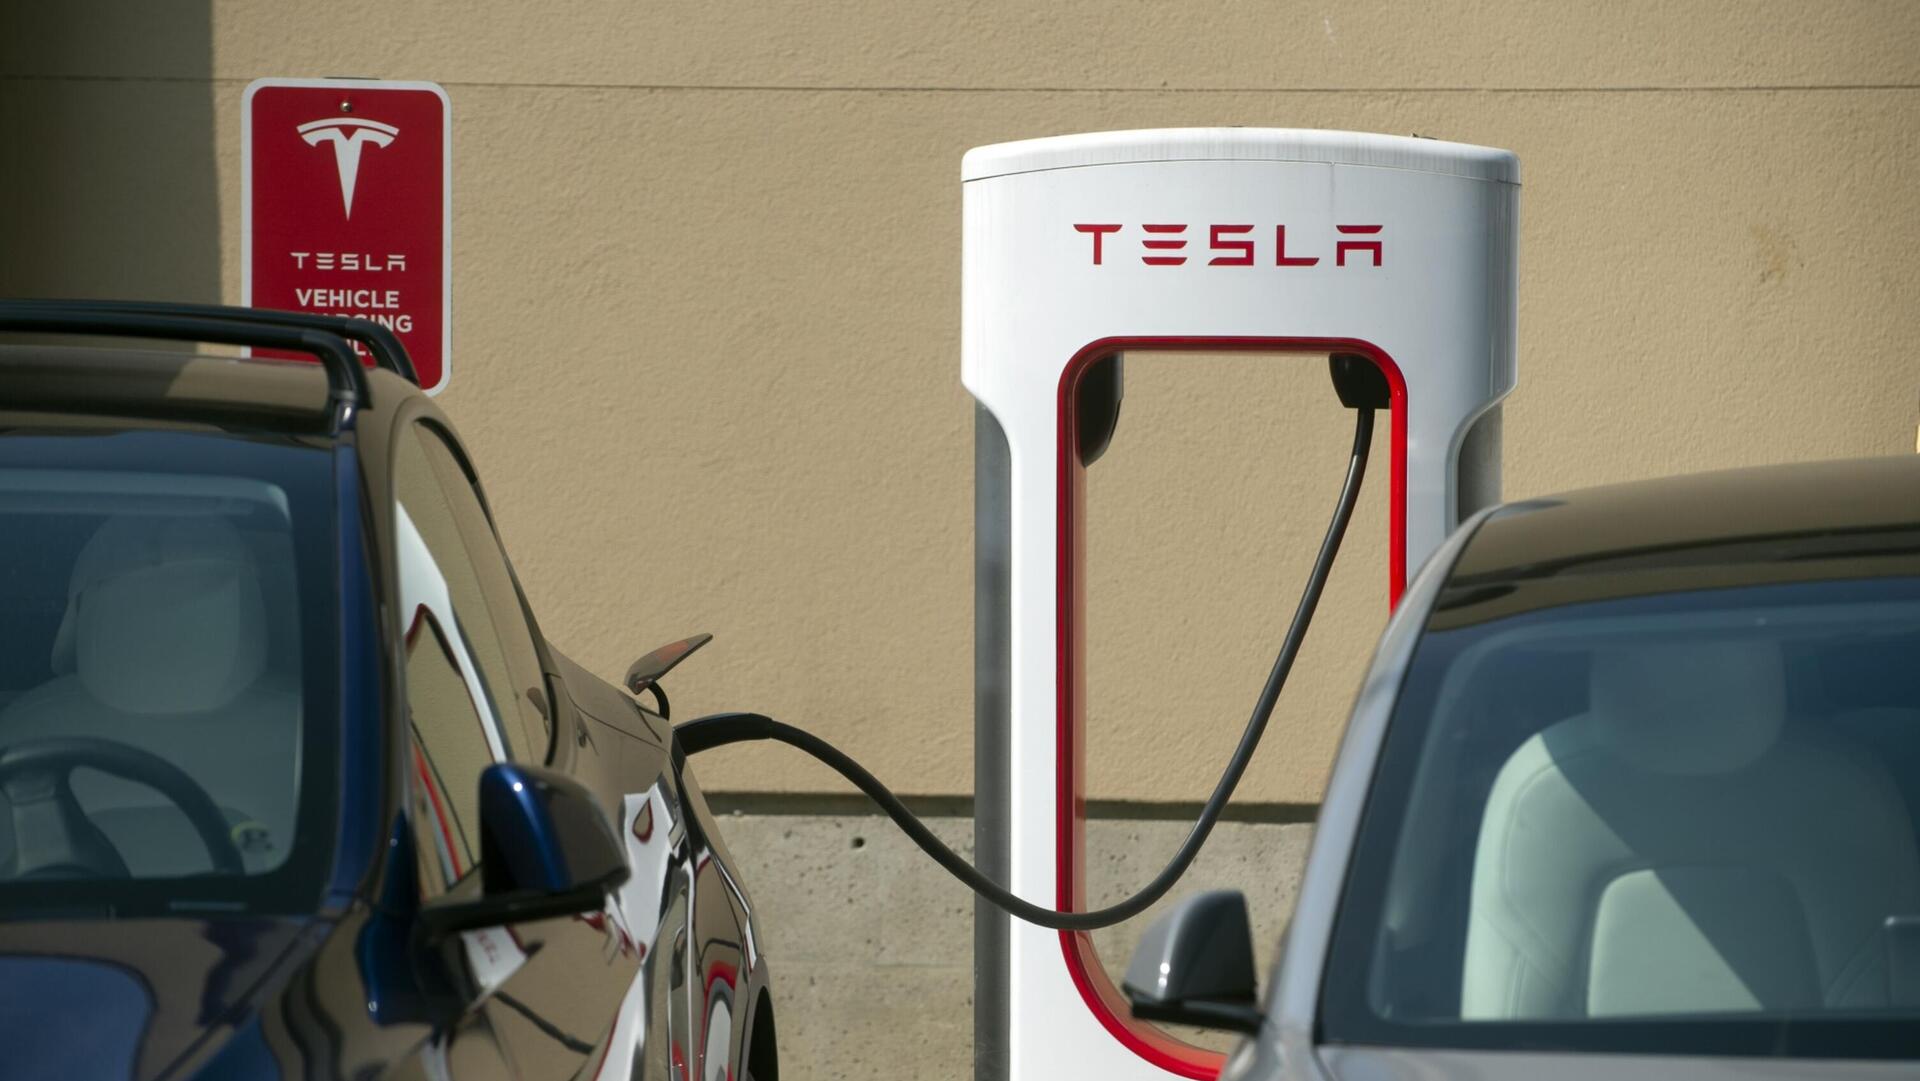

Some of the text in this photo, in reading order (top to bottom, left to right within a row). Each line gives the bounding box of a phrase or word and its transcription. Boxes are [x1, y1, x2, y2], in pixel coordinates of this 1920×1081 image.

[1073, 224, 1383, 266] TESLA
[290, 252, 406, 271] TESLA
[295, 288, 400, 309] VEHICLE
